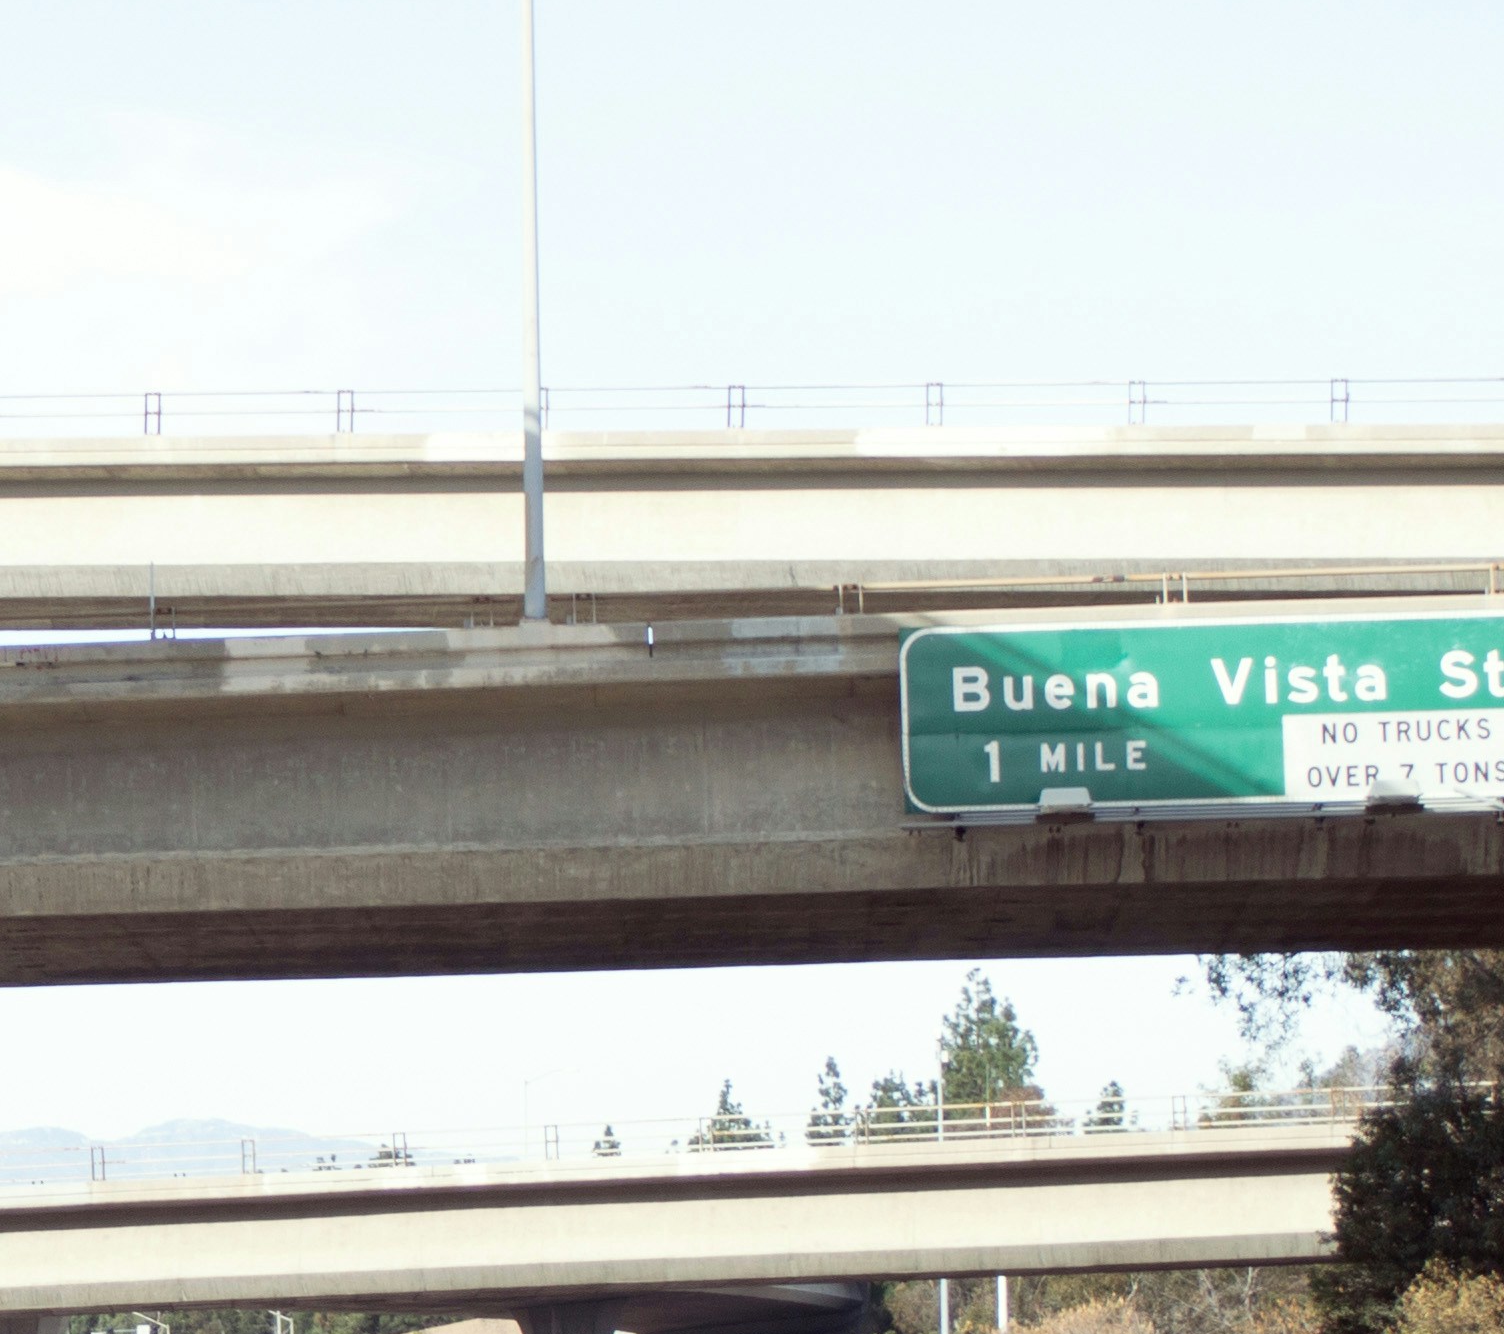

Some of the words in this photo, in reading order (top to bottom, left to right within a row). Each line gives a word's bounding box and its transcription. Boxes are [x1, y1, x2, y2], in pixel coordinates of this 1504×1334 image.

[952, 666, 1159, 712] Buena
[1211, 654, 1388, 705] Vista
[1322, 722, 1358, 744] NO
[1378, 718, 1492, 743] TRUCKS
[983, 740, 1000, 783] 1
[1040, 740, 1147, 773] MILE
[1307, 765, 1380, 788] OVER
[1399, 764, 1414, 779] 7
